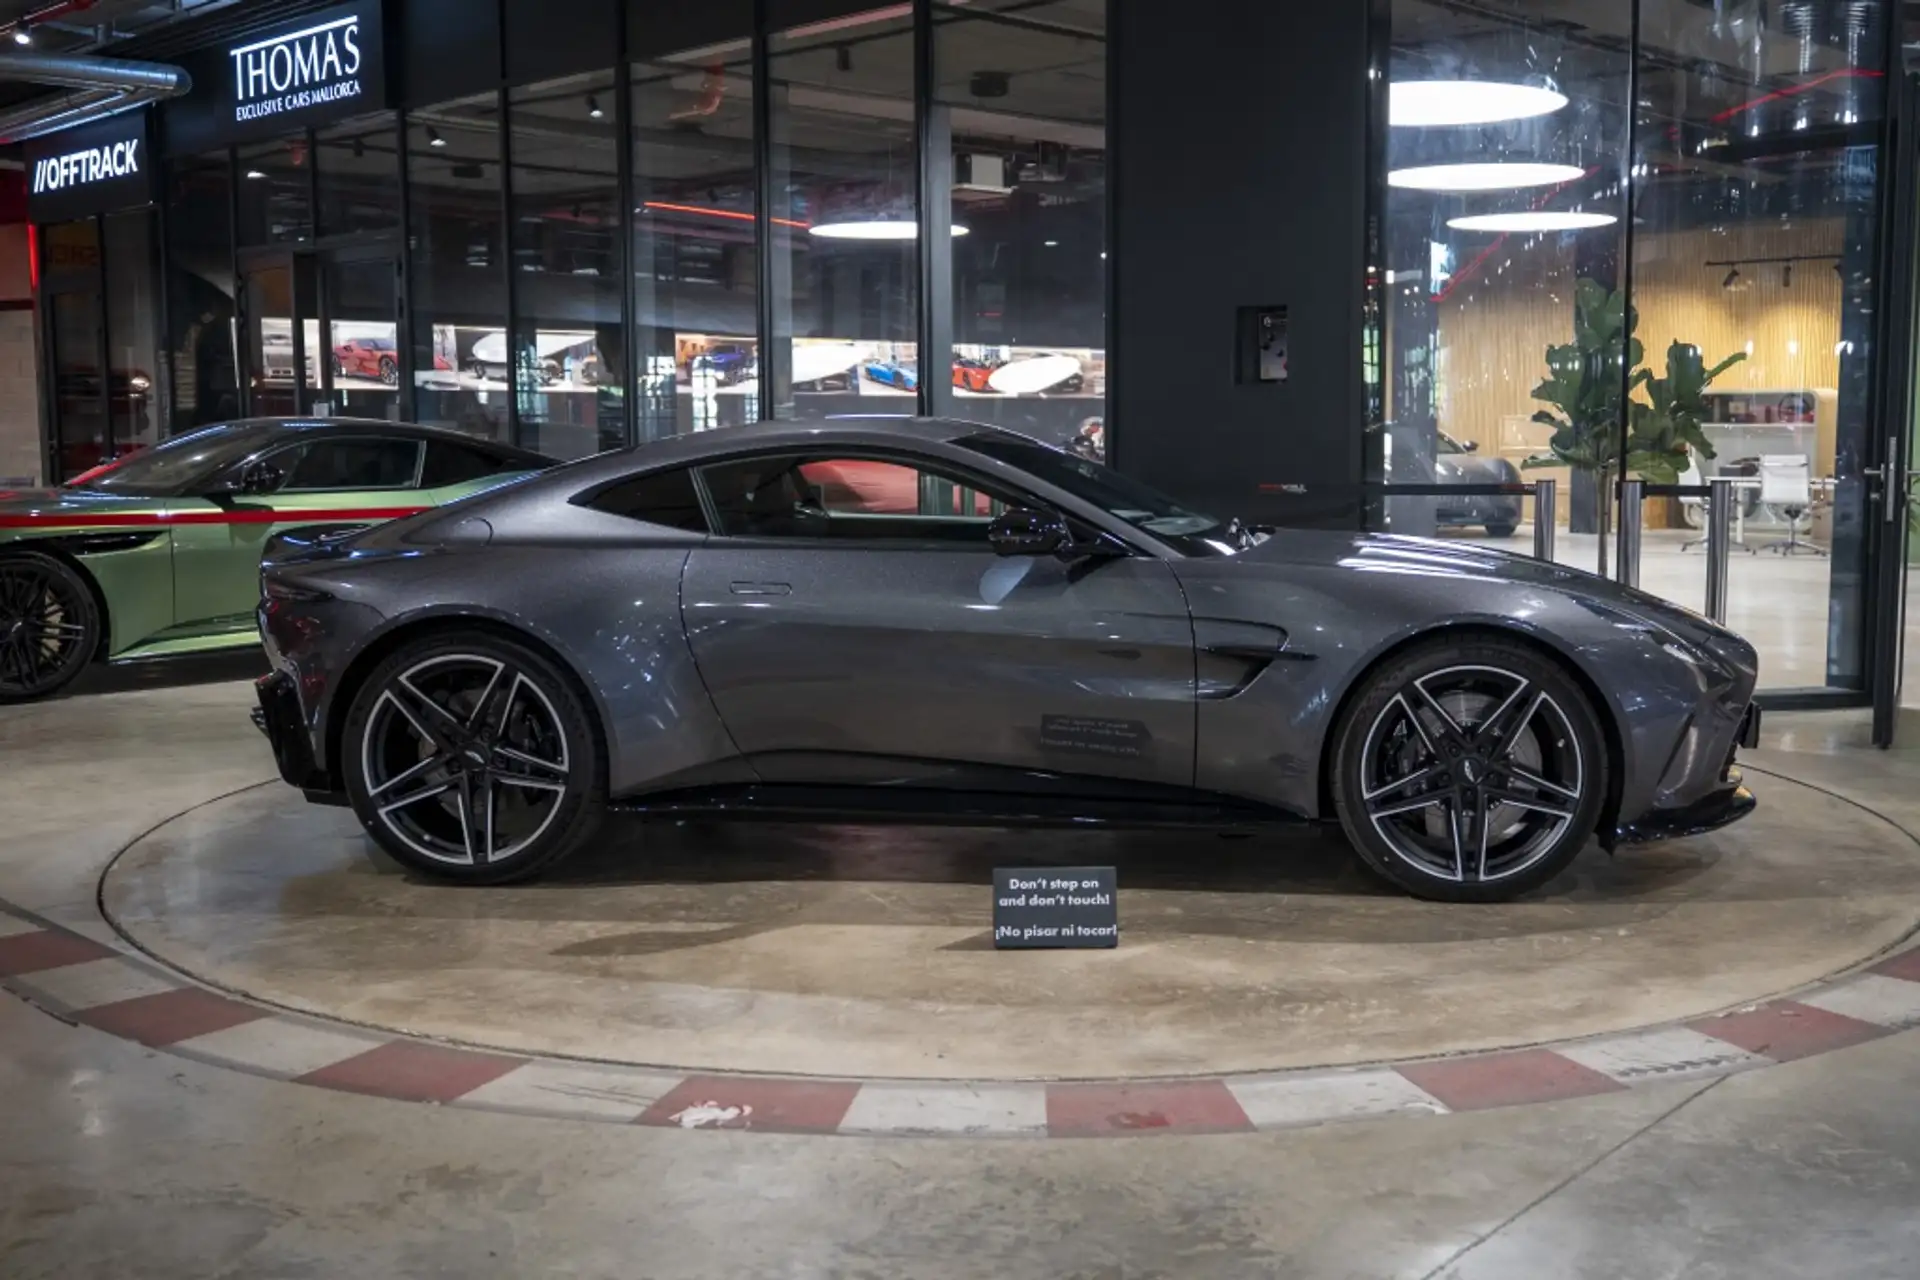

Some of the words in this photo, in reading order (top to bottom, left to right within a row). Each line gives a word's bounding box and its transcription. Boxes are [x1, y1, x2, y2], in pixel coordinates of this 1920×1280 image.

[230, 15, 361, 100] THOMAS
[236, 98, 283, 122] EXCLUSIVE
[286, 91, 311, 111] CARS
[311, 80, 361, 104] MALLORCA
[1009, 878, 1047, 890] Don't
[1050, 878, 1078, 892] step
[1082, 880, 1099, 888] on
[999, 895, 1026, 906] and
[1029, 895, 1065, 906] don't
[1068, 894, 1110, 905] touch!
[995, 926, 1021, 940] ¡No
[1024, 925, 1058, 940] pisar
[1061, 925, 1074, 936] ni
[1077, 925, 1117, 936] tocar!
